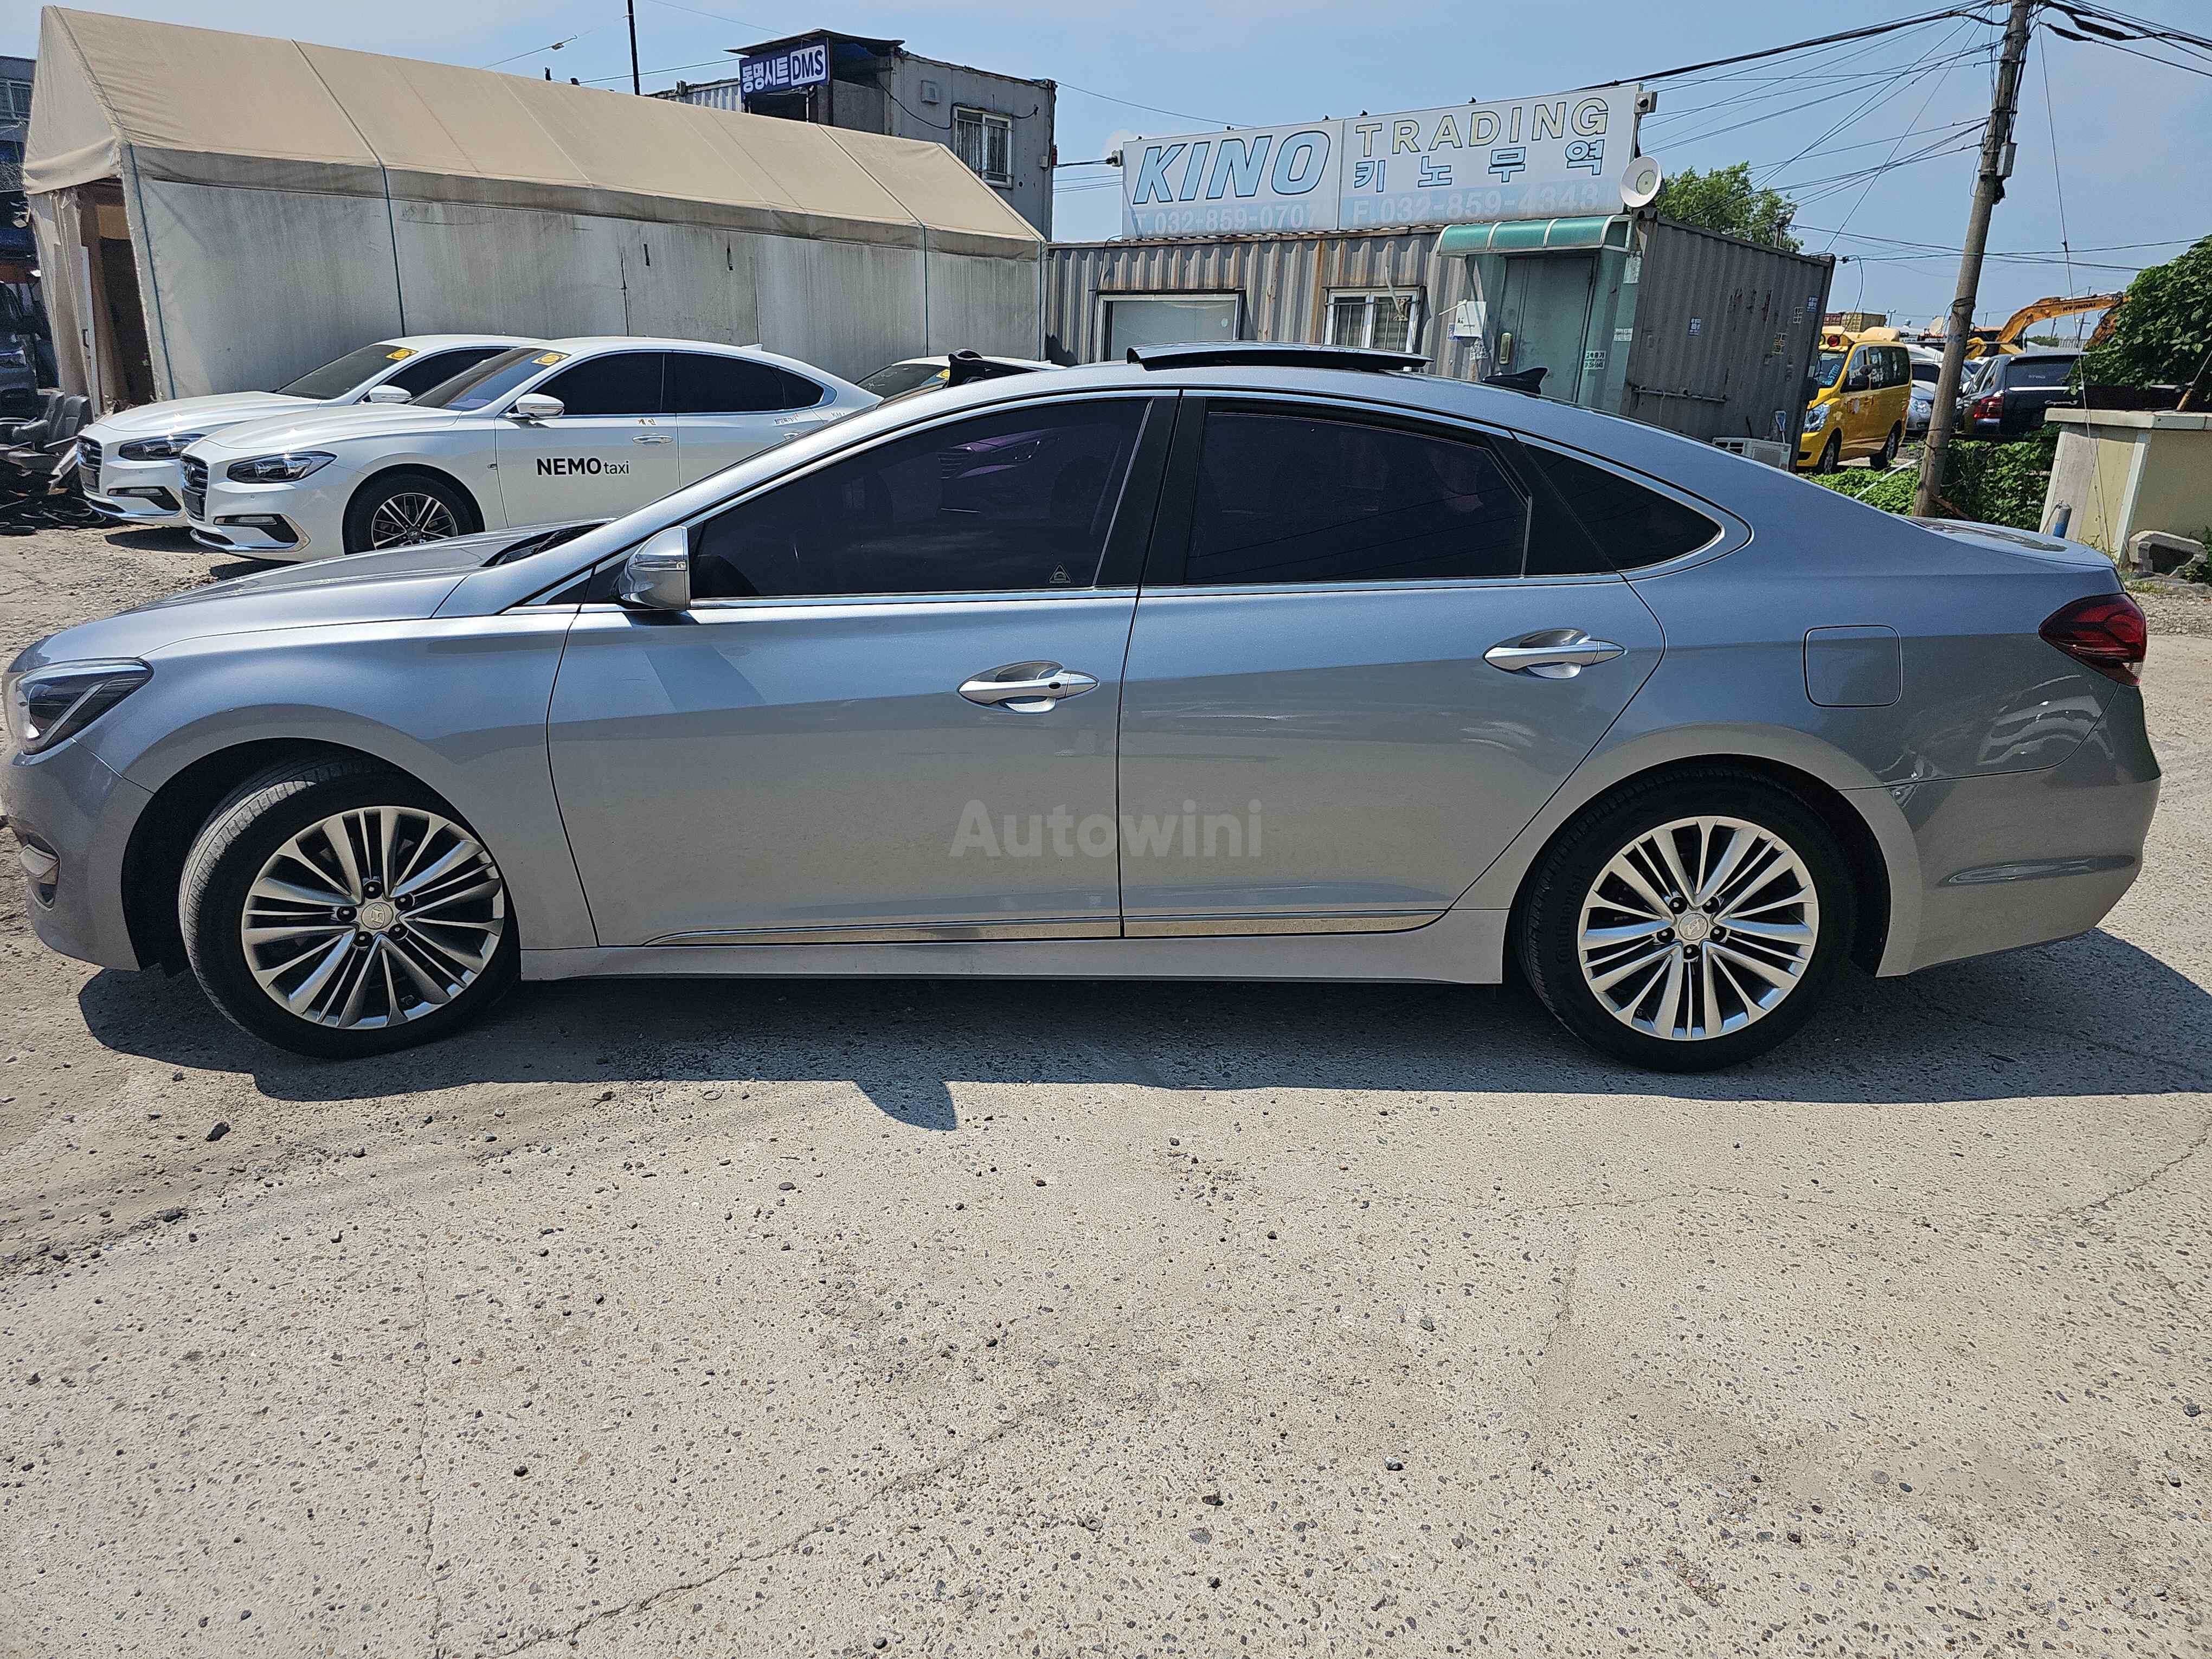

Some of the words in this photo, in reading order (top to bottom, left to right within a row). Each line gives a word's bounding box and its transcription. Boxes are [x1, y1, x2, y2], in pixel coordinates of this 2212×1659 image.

[742, 56, 789, 93] 동명시트
[792, 49, 824, 81] DMS
[1355, 98, 1609, 157] TRADING
[1133, 130, 1331, 205] KINO
[536, 458, 602, 475] NEMO
[603, 461, 629, 474] taxi
